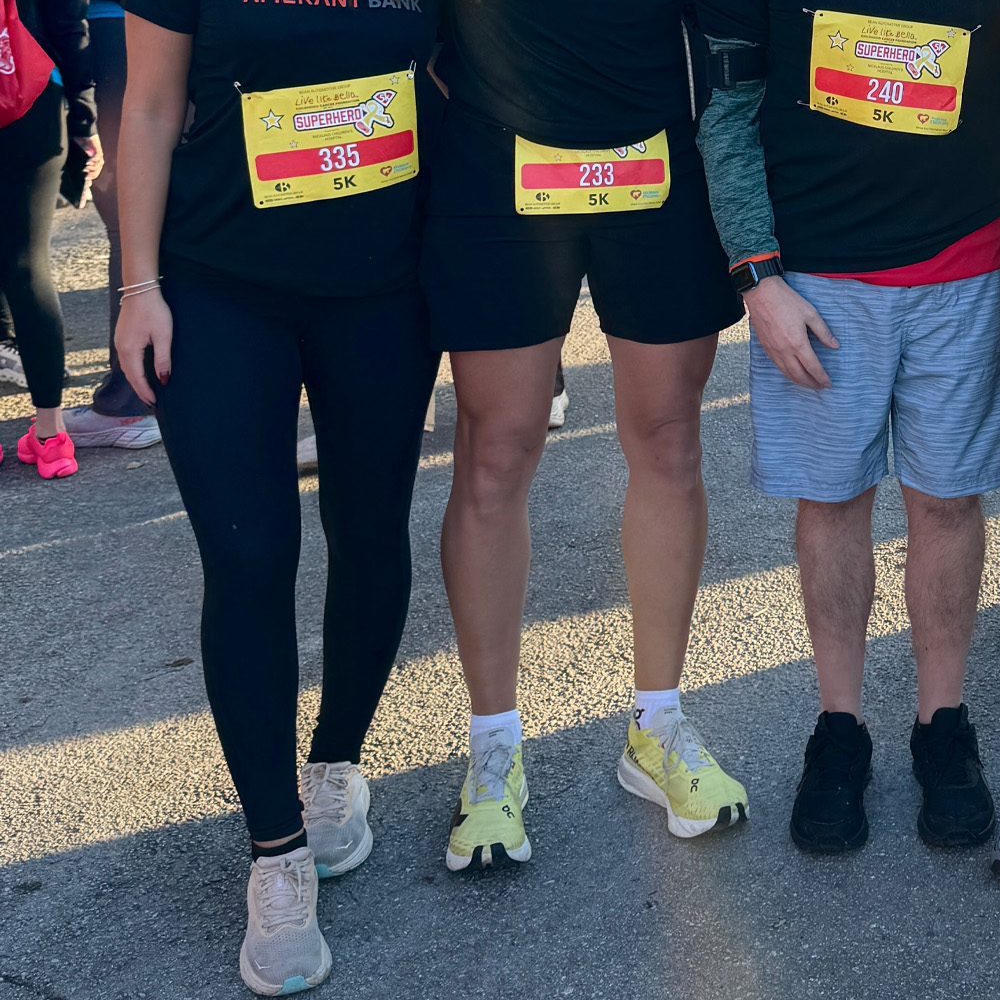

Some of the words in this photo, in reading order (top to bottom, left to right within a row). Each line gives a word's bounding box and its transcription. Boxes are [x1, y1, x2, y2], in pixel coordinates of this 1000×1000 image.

[857, 44, 915, 62] SUPERHERO
[867, 78, 904, 105] 240
[296, 108, 361, 129] SUPERHERO
[872, 108, 894, 124] 5K
[318, 143, 360, 172] 335
[333, 174, 358, 190] 5K
[580, 162, 614, 187] 233
[588, 192, 609, 206] 5K
